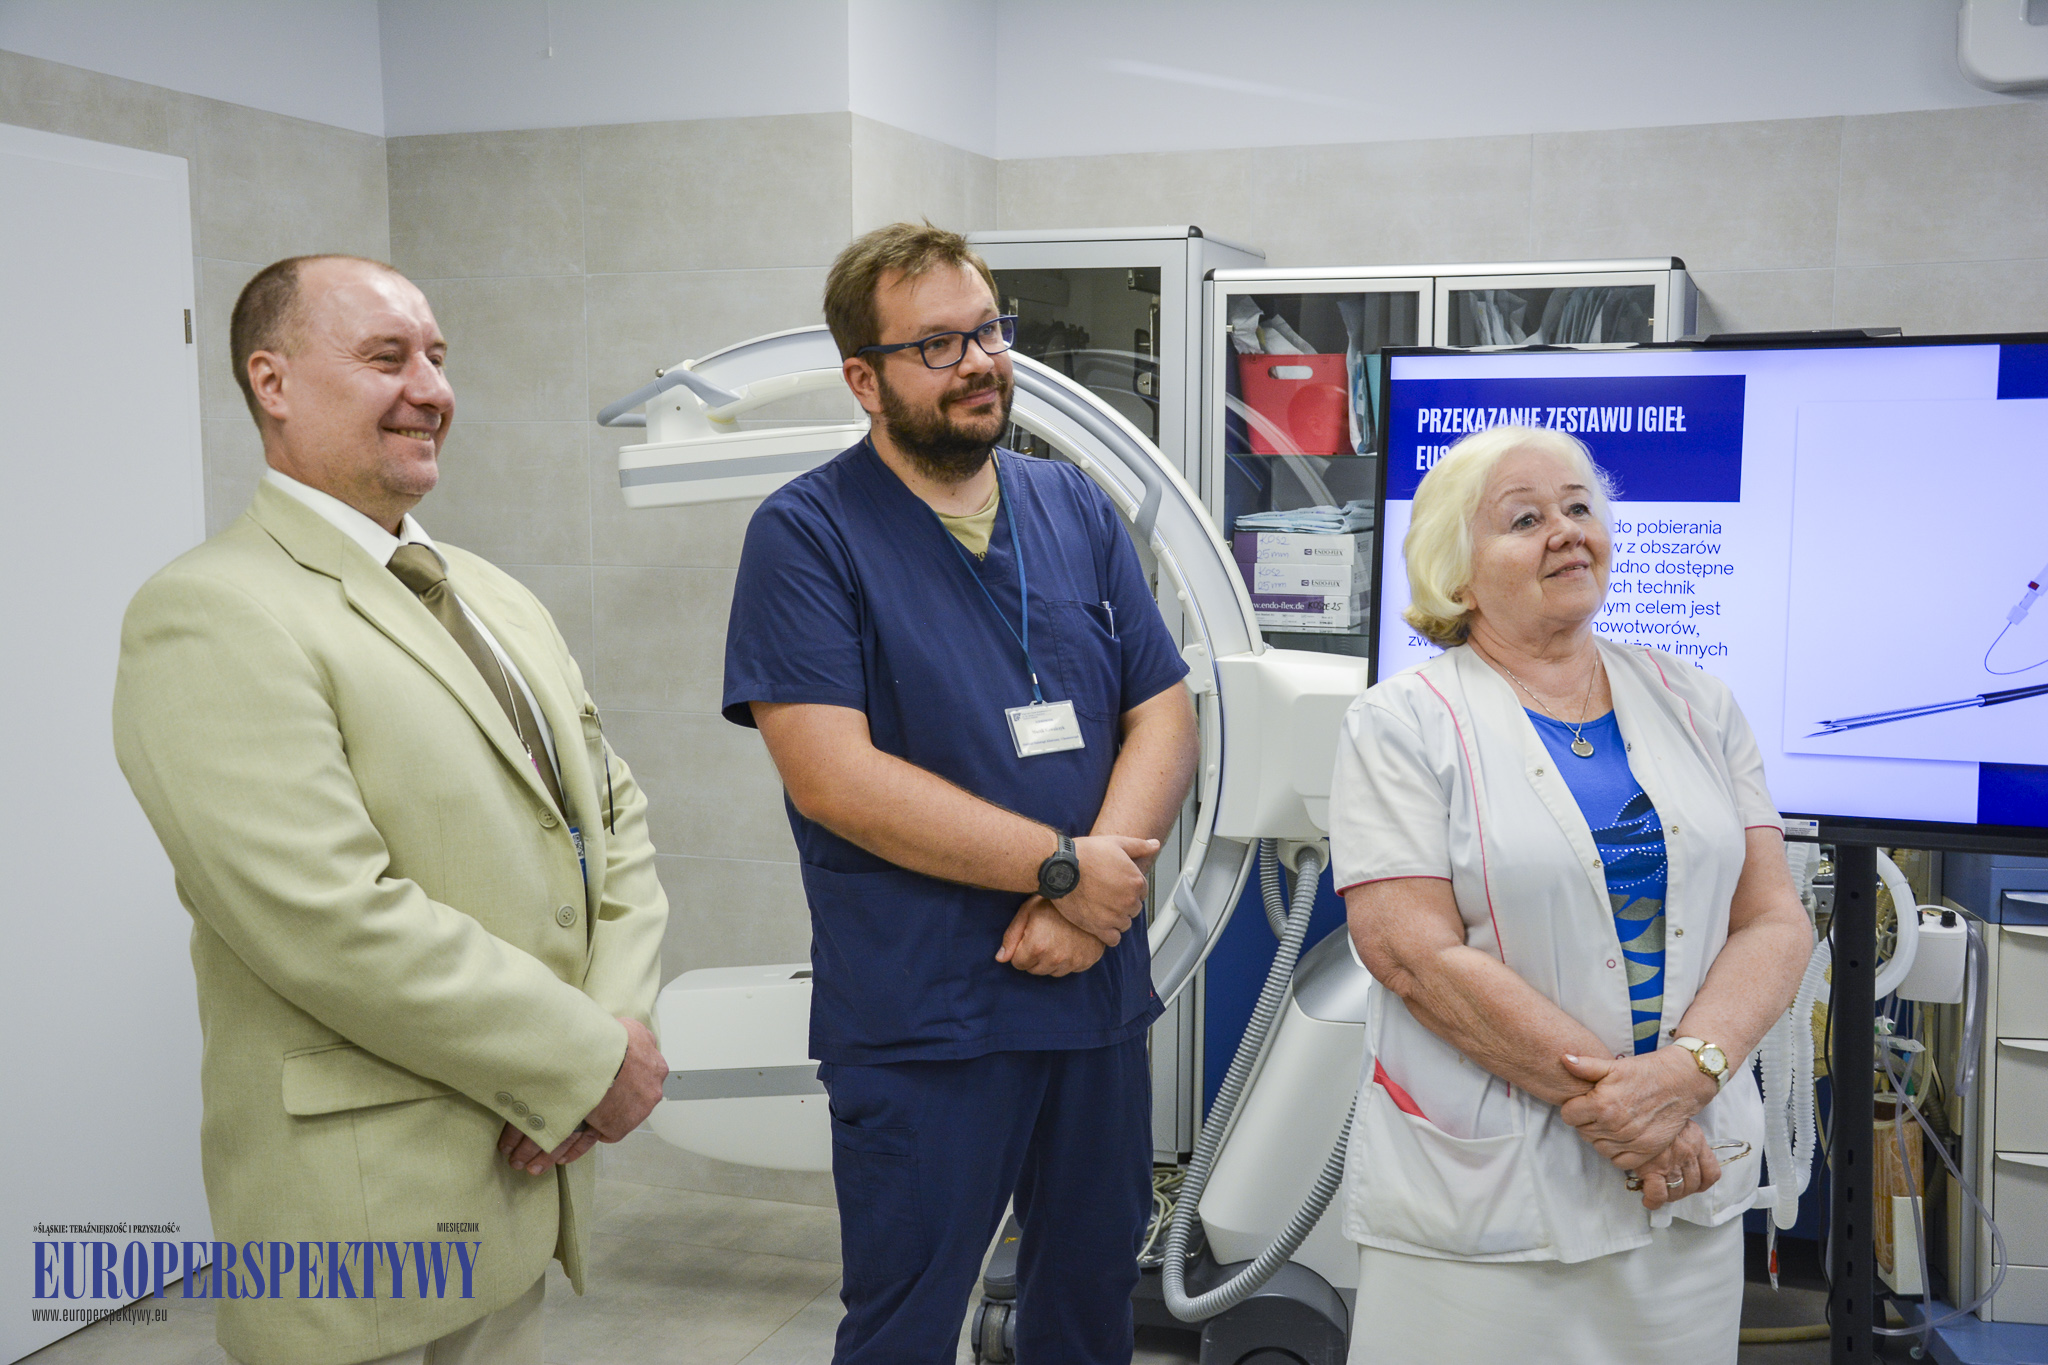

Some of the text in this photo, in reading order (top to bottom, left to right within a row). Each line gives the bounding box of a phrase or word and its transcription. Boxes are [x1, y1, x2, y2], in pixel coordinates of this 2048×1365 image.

[1417, 406, 1687, 433] PRZEKAZANIE ZESTAWU IGIEŁ
[1637, 519, 1722, 537] pobierania
[1627, 542, 1636, 554] z
[1640, 540, 1721, 555] obszarów
[1655, 560, 1734, 578] dostępne
[1637, 579, 1696, 595] technik
[1635, 600, 1686, 615] celem
[1689, 601, 1721, 619] jest
[1591, 620, 1700, 638] nowotworów,
[1675, 640, 1728, 659] innych
